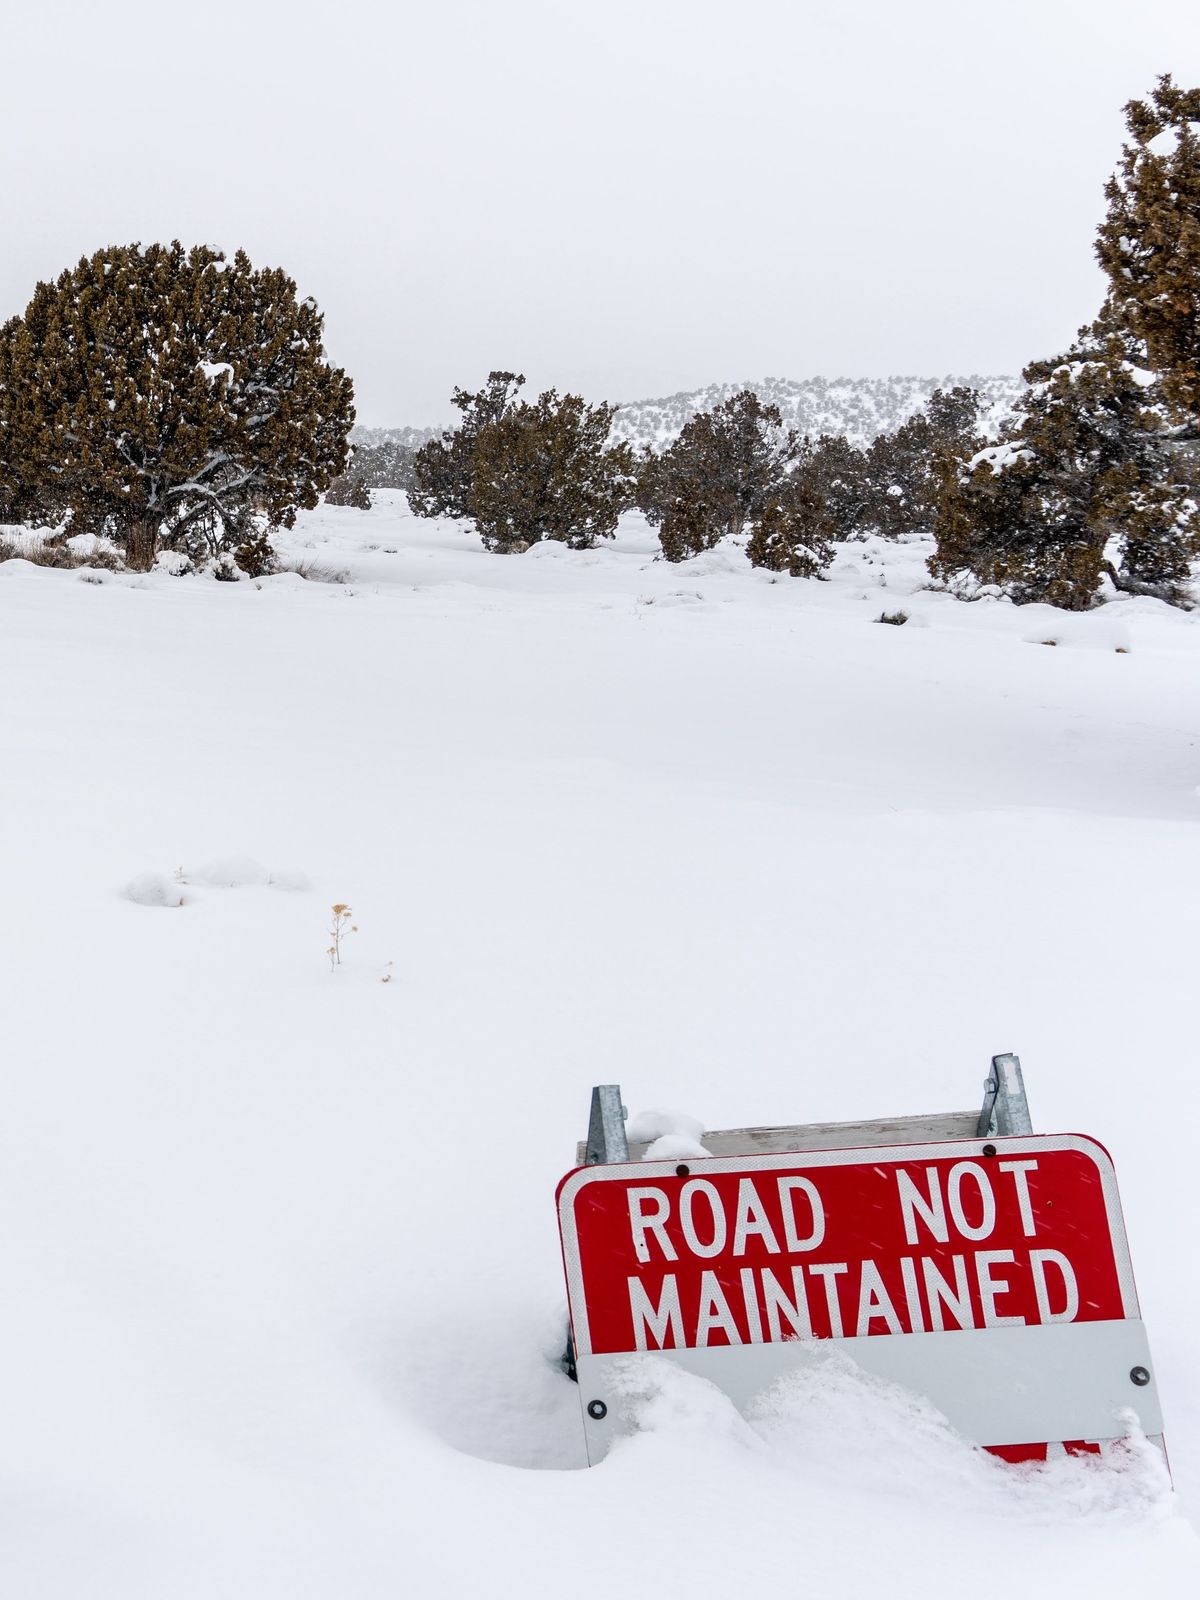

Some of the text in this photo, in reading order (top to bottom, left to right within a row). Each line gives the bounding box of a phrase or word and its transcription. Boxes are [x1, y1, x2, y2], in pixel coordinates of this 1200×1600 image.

[626, 1159, 1038, 1263] ROAD NOT
[627, 1249, 1079, 1351] MAINTAINED
